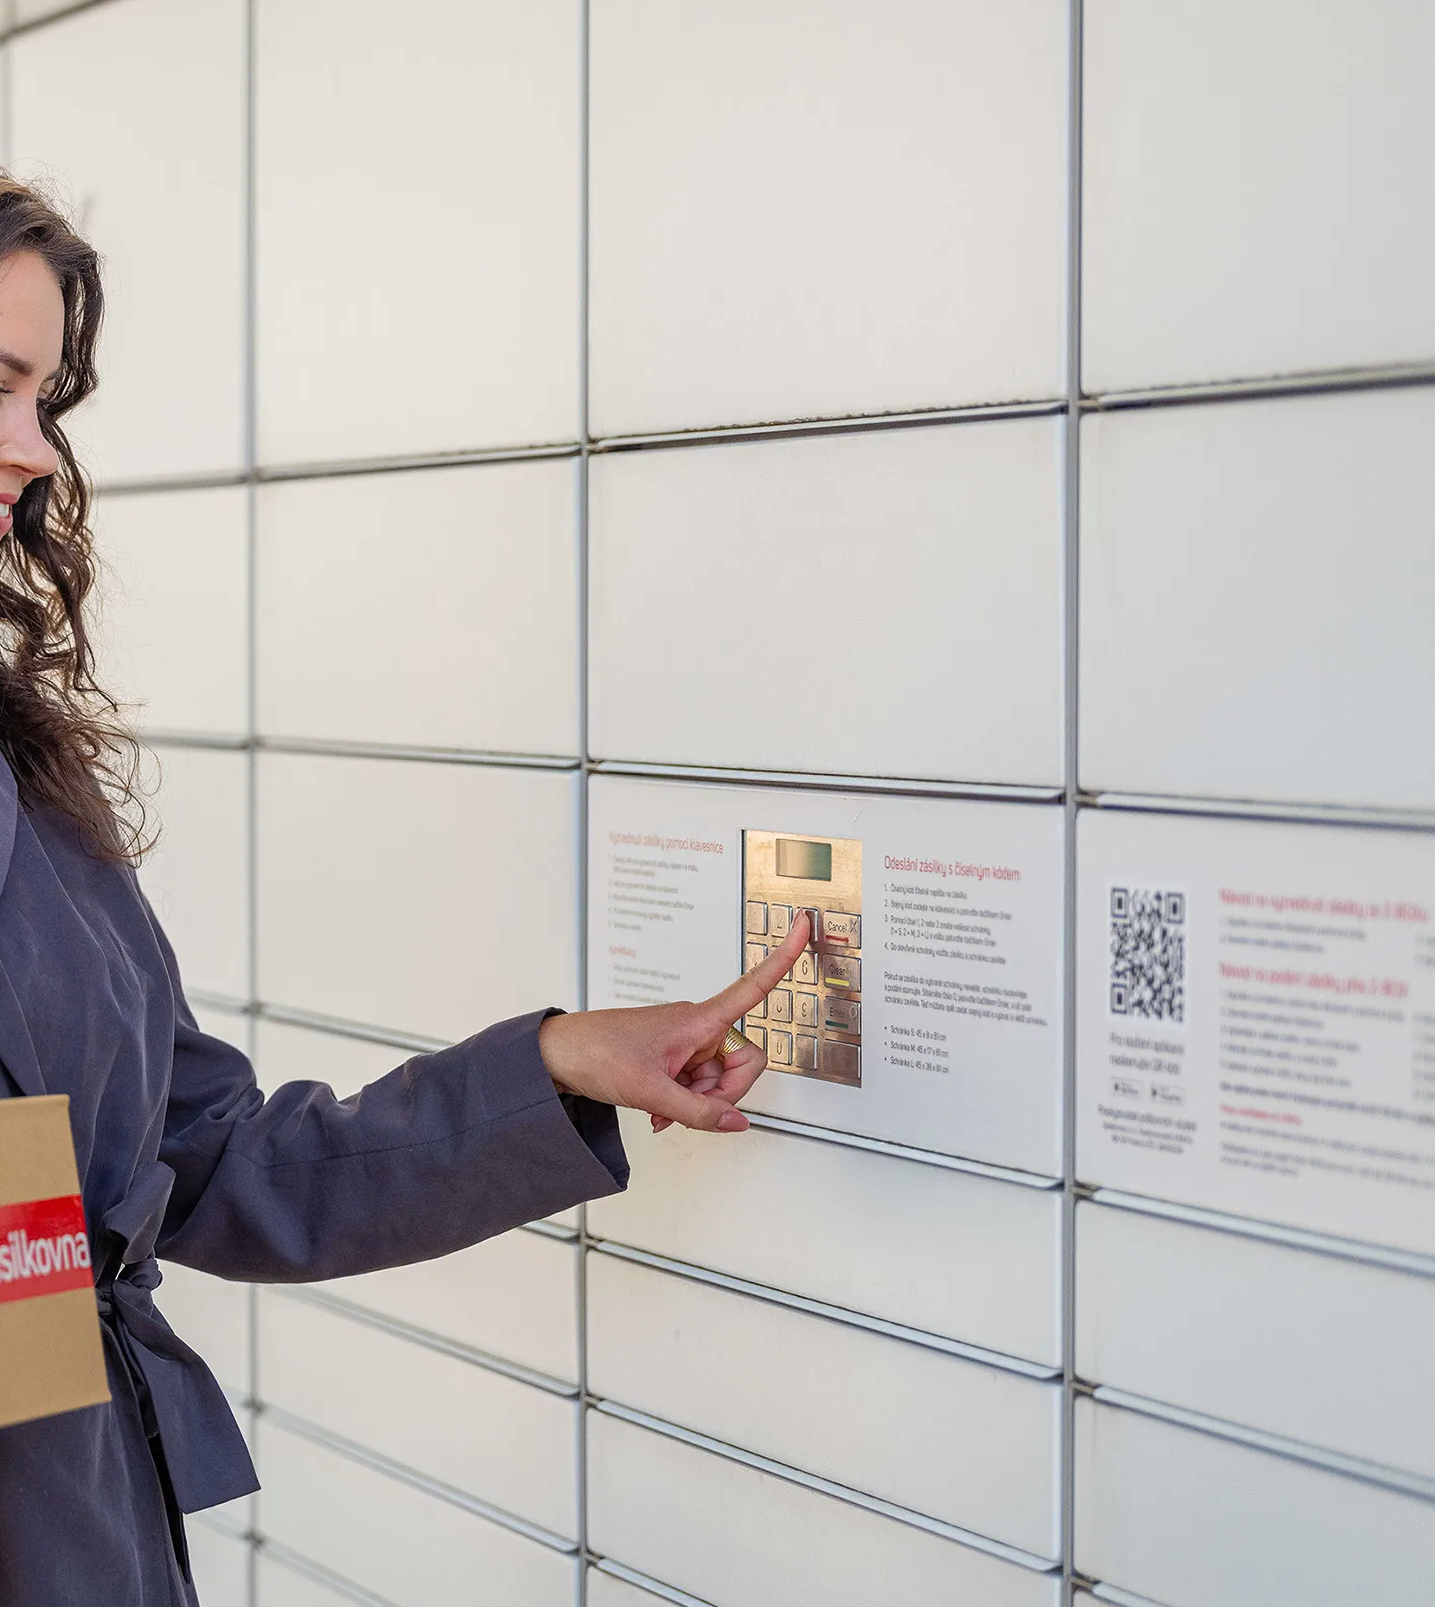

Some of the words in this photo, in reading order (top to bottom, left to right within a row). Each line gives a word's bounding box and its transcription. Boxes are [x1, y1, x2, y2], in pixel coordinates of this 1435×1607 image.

[690, 837, 724, 853] klávesnice
[884, 855, 917, 872] Odeslání
[919, 858, 946, 877] zásilky
[948, 864, 953, 875] s
[827, 921, 847, 933] Cancel
[829, 963, 845, 976] Clear
[829, 1006, 845, 1018] Enter
